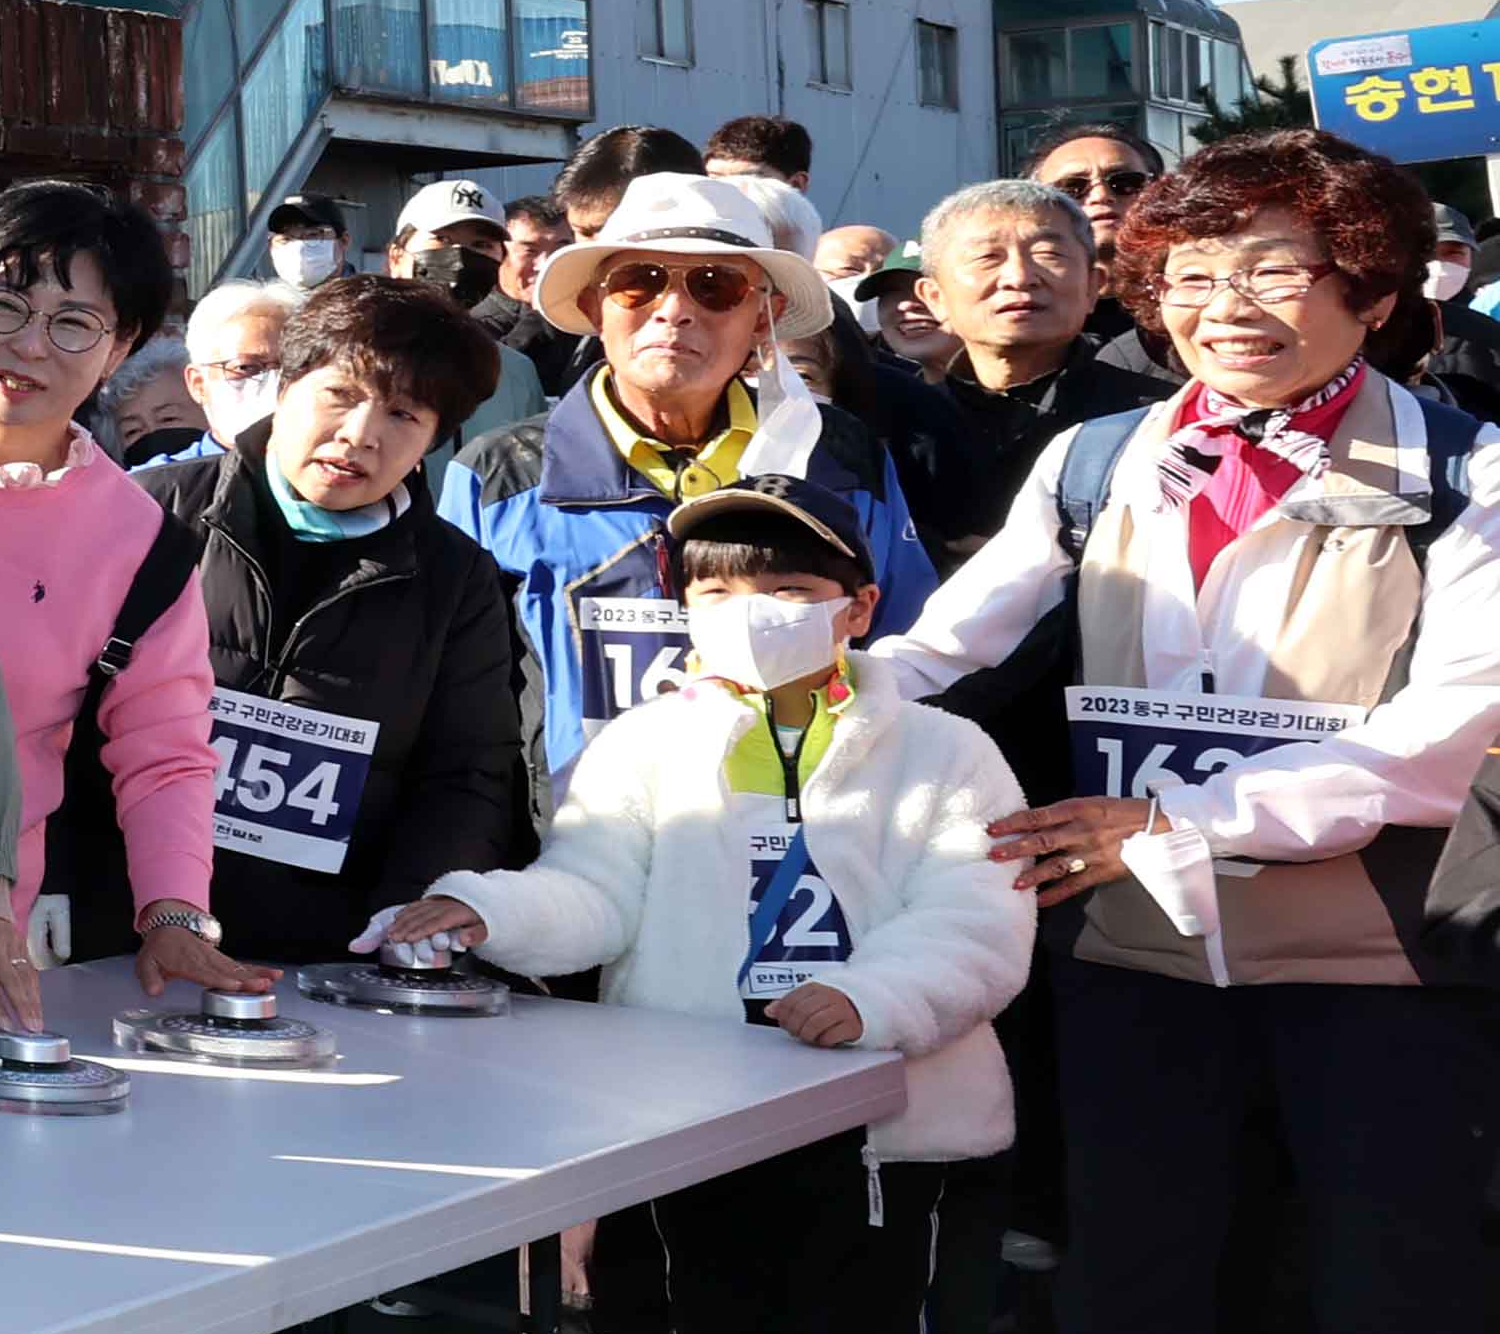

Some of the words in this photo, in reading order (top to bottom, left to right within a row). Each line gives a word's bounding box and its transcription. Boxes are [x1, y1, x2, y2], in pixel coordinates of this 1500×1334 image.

[591, 608, 636, 623] 2023
[642, 609, 673, 624] 동구
[240, 704, 367, 745] 구민건강걷기대회
[1080, 696, 1130, 715] 2023
[1133, 700, 1171, 719] 동구
[1174, 705, 1347, 733] 구민건강걷기대회
